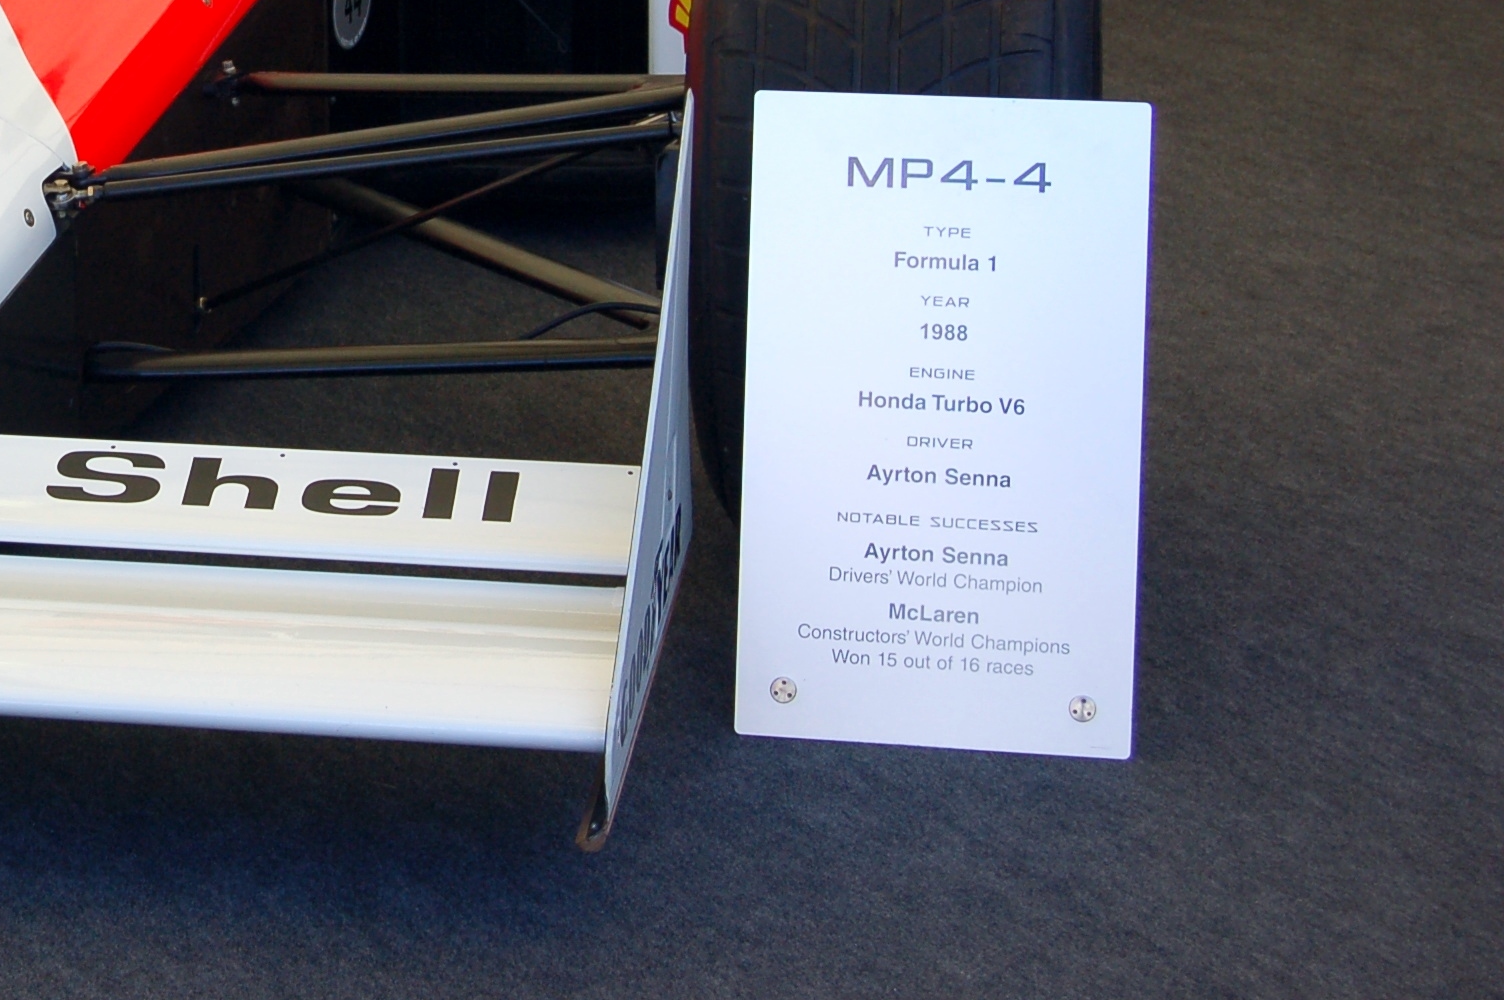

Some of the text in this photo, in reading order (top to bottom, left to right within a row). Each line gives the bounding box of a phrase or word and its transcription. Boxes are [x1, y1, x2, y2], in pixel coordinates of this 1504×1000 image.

[846, 155, 1052, 194] MP4-4
[923, 225, 972, 240] TYPE
[893, 250, 997, 273] Formula 1
[920, 295, 970, 309] YEAR
[919, 322, 968, 343] 1988
[909, 366, 976, 381] ENGINE
[858, 390, 1026, 416] Honda Turbo V6
[906, 435, 974, 450] DRIVER
[46, 450, 520, 523] Shell
[865, 463, 1011, 489] Ayrton Senna
[836, 511, 1039, 534] NOTABLE SUCCESSES
[863, 541, 1009, 567] Ayrton Senna
[828, 565, 1043, 596] Drivers' World Champion
[888, 602, 980, 625] McLaren
[797, 622, 1071, 657] Constructors' World Champions
[831, 648, 1034, 677] Won 15 out of 16 races
